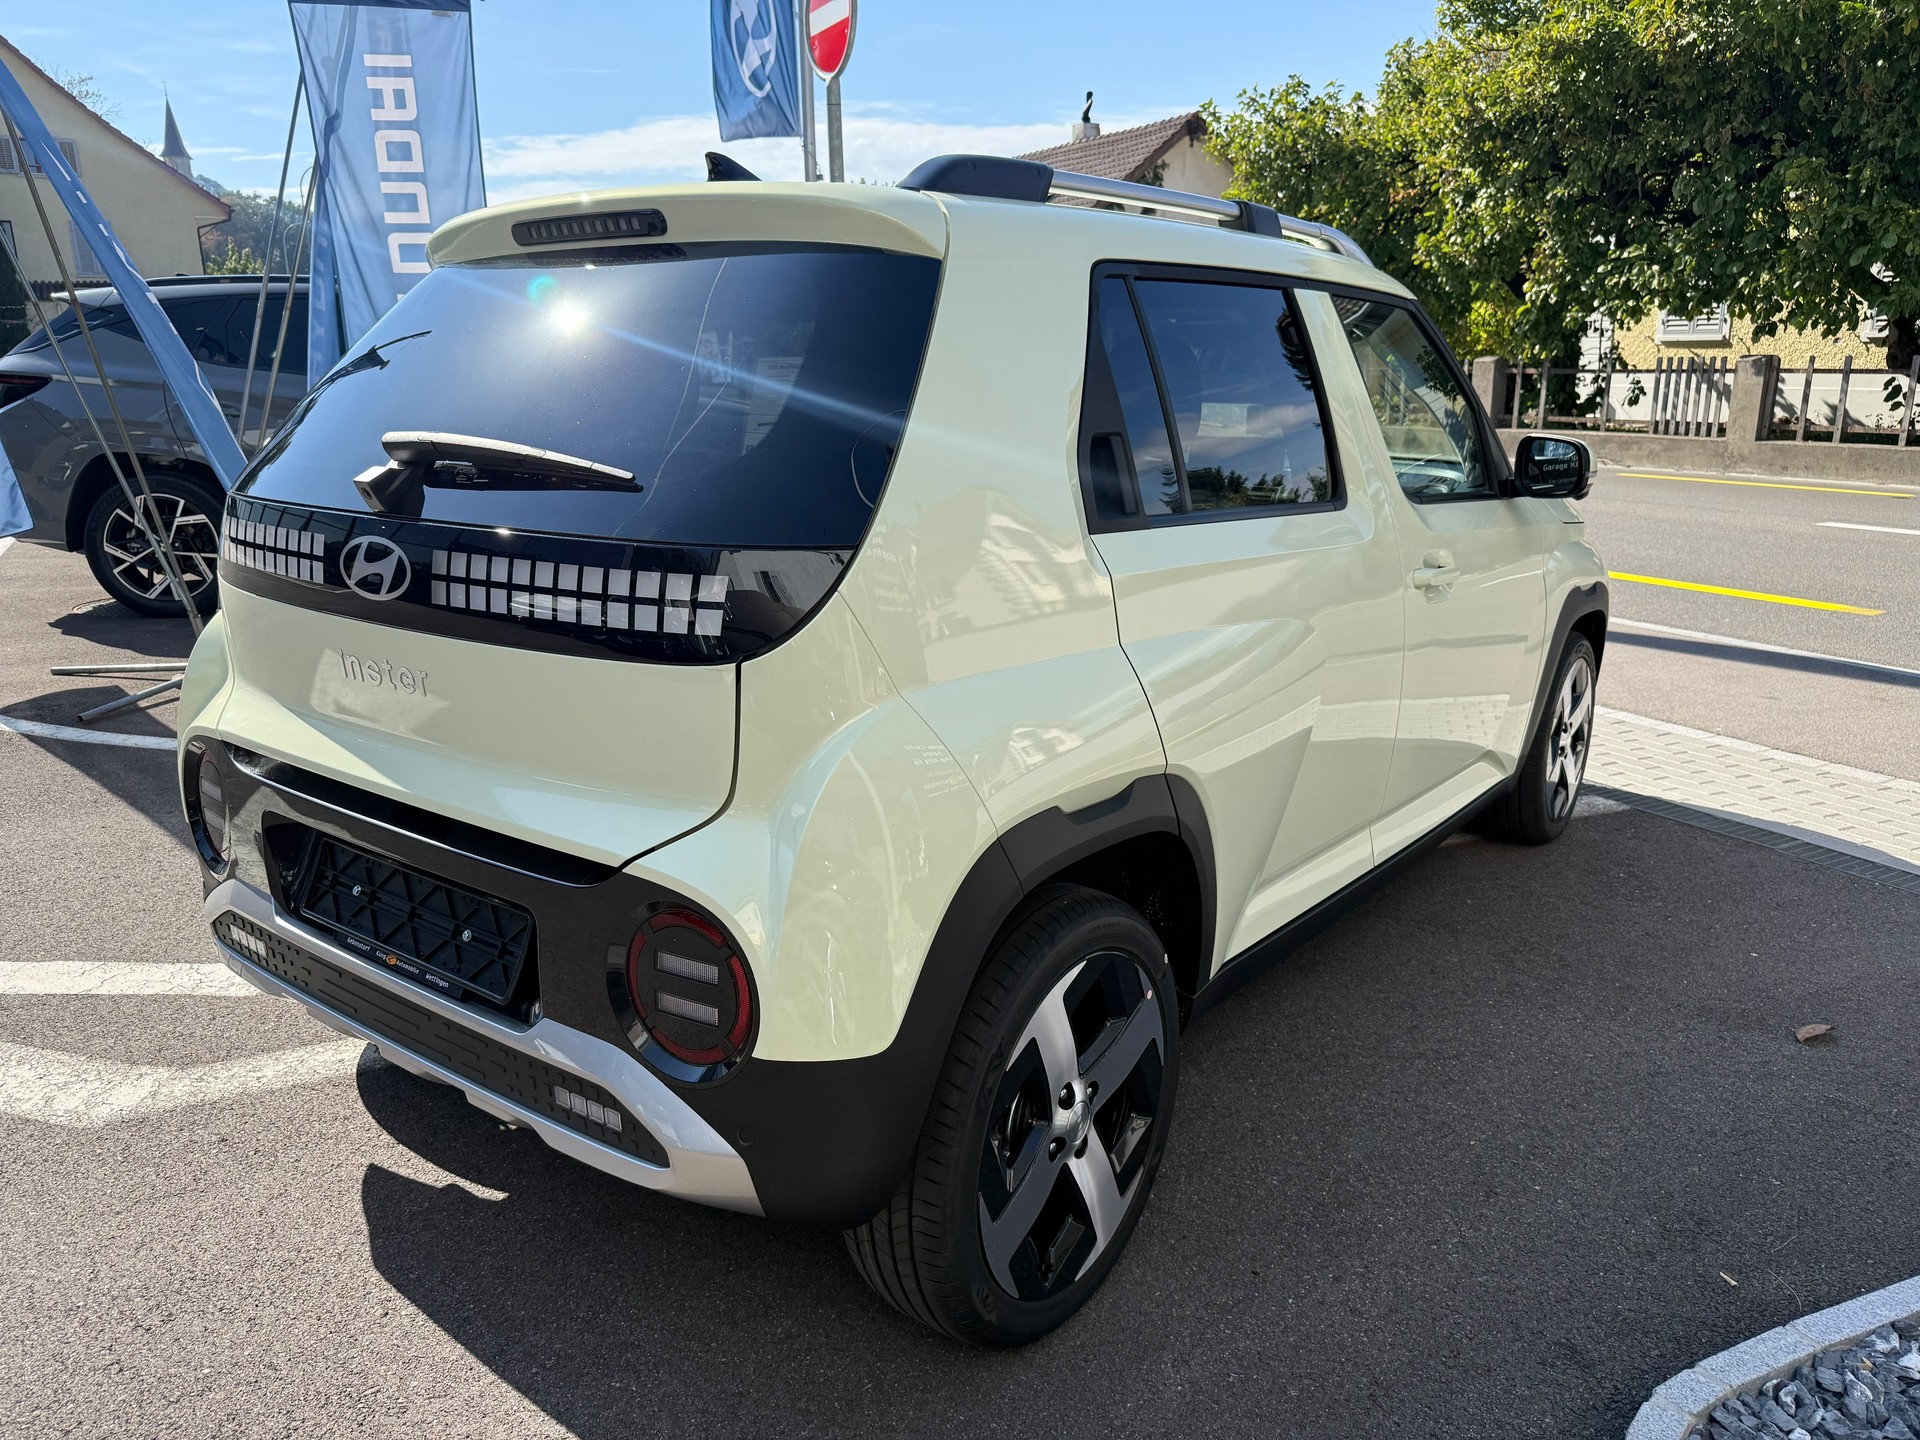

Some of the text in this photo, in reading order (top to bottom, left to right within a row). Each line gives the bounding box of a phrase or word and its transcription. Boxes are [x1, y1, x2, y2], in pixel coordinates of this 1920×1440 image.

[1543, 463, 1568, 472] Garage
[338, 648, 428, 697] inster
[346, 936, 371, 952] Gebenstorf
[396, 959, 420, 975] Automobile
[425, 972, 449, 989] Wettingen
